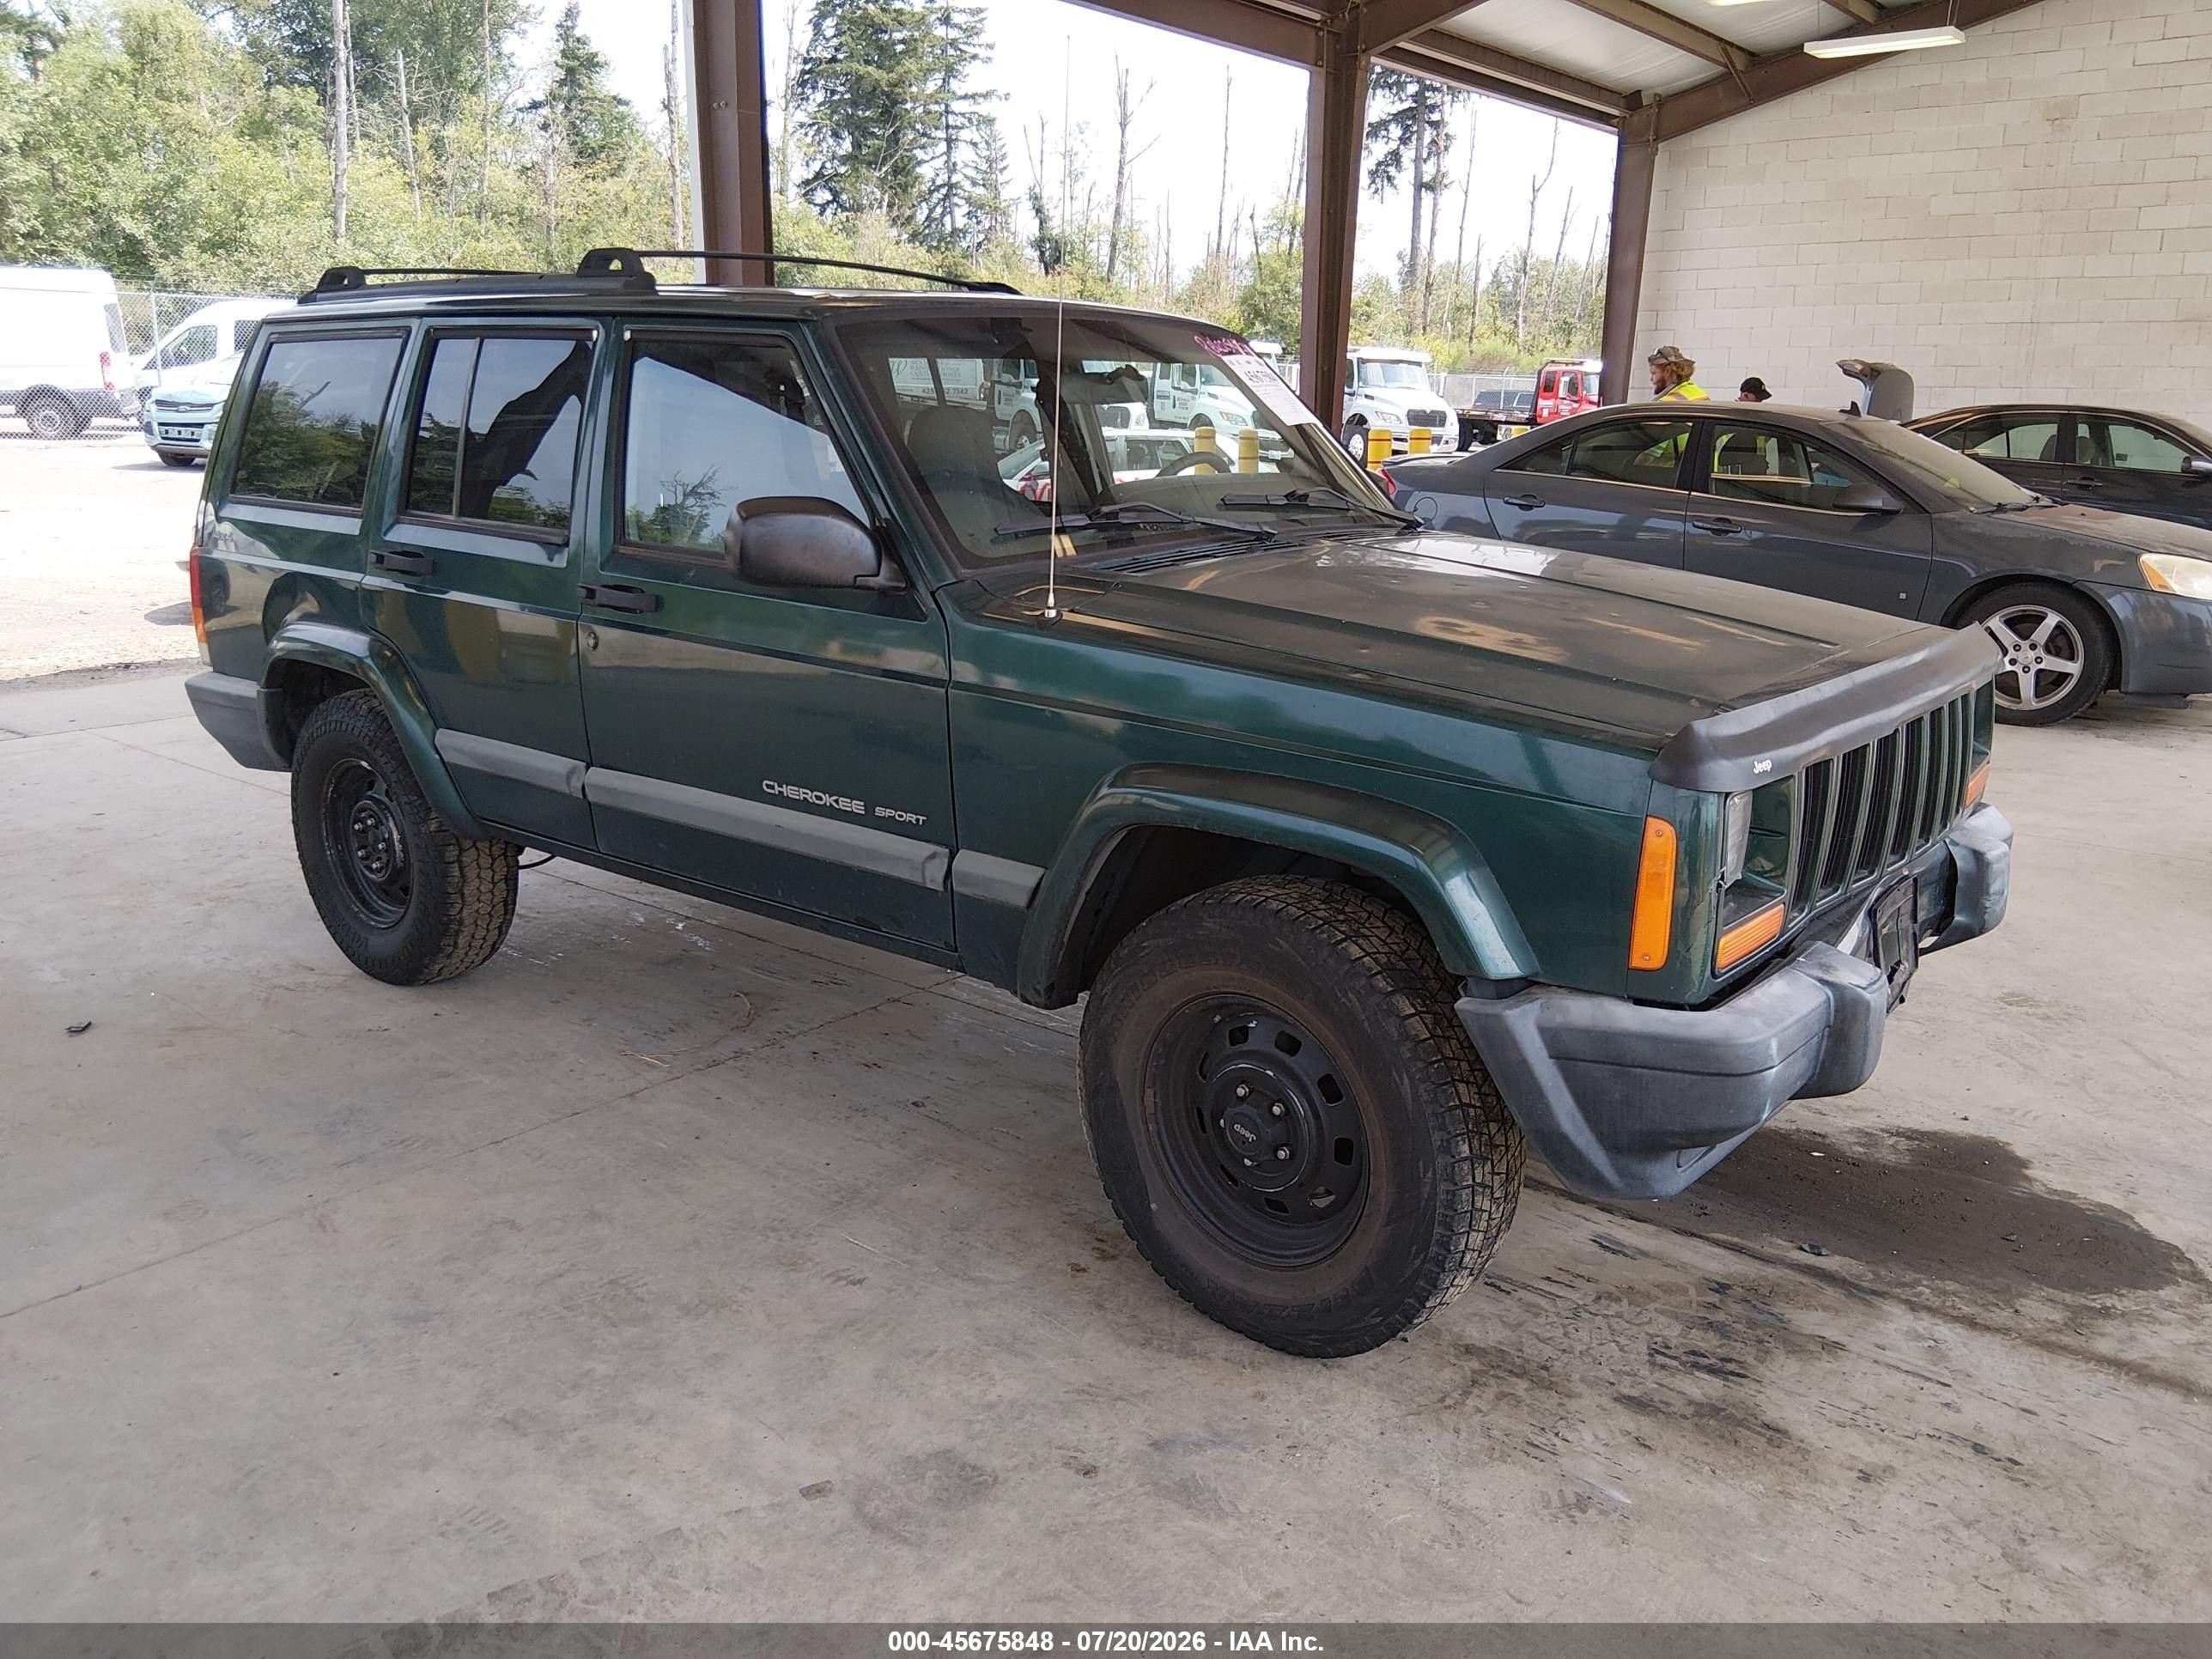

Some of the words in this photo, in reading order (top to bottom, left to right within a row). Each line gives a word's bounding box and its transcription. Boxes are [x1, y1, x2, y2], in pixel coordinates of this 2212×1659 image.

[1753, 759, 1772, 774] Jeep
[762, 780, 866, 814] CHEROKEE
[874, 806, 927, 825] SPORT
[1234, 1123, 1257, 1142] Jeep
